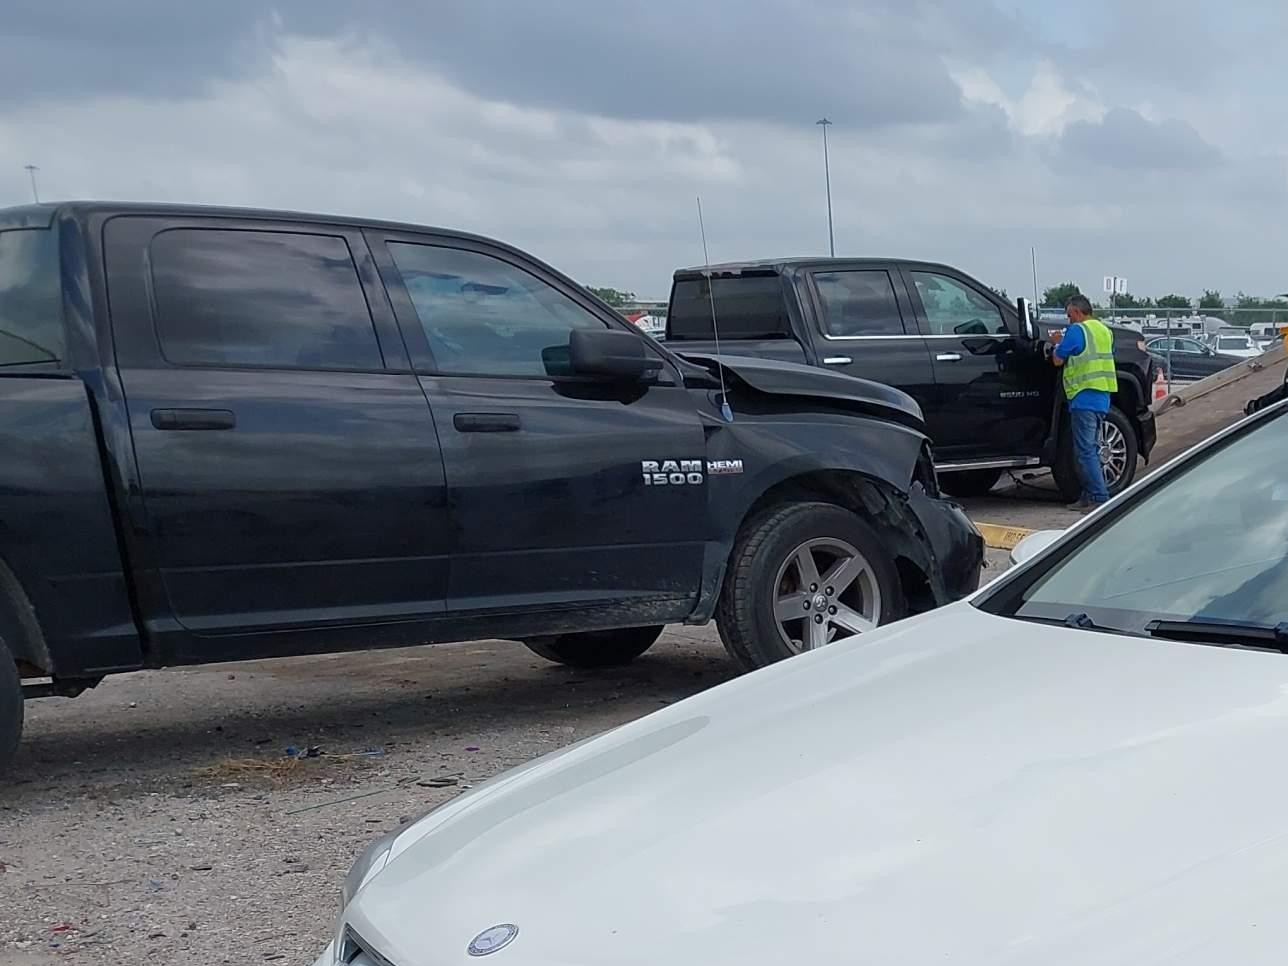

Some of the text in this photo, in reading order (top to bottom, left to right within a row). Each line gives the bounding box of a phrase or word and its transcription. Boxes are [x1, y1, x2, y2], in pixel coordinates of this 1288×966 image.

[641, 460, 703, 473] RAM
[706, 459, 743, 469] HEMI
[642, 472, 704, 486] 1500
